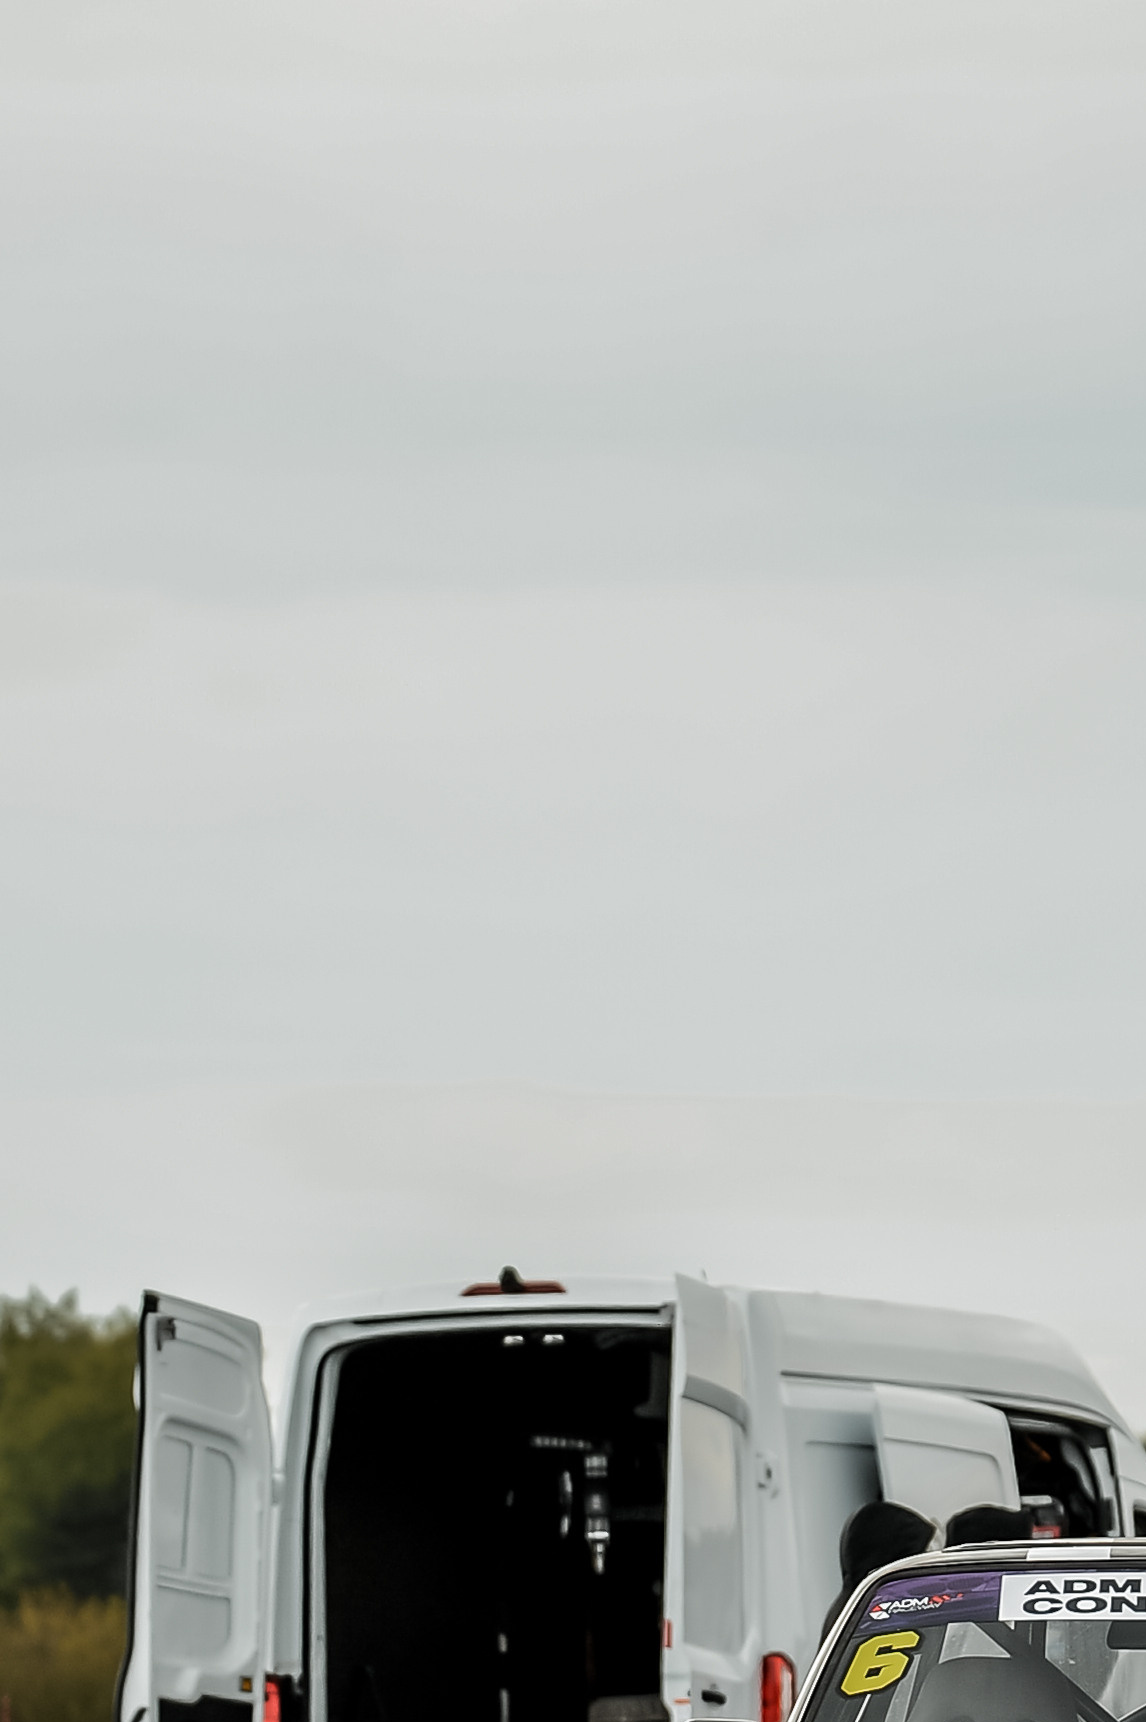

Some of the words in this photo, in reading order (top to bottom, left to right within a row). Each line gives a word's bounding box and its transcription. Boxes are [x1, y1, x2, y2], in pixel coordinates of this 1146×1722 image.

[1024, 1578, 1142, 1595] ADM
[889, 1597, 930, 1610] ADM
[840, 1631, 921, 1696] 6
